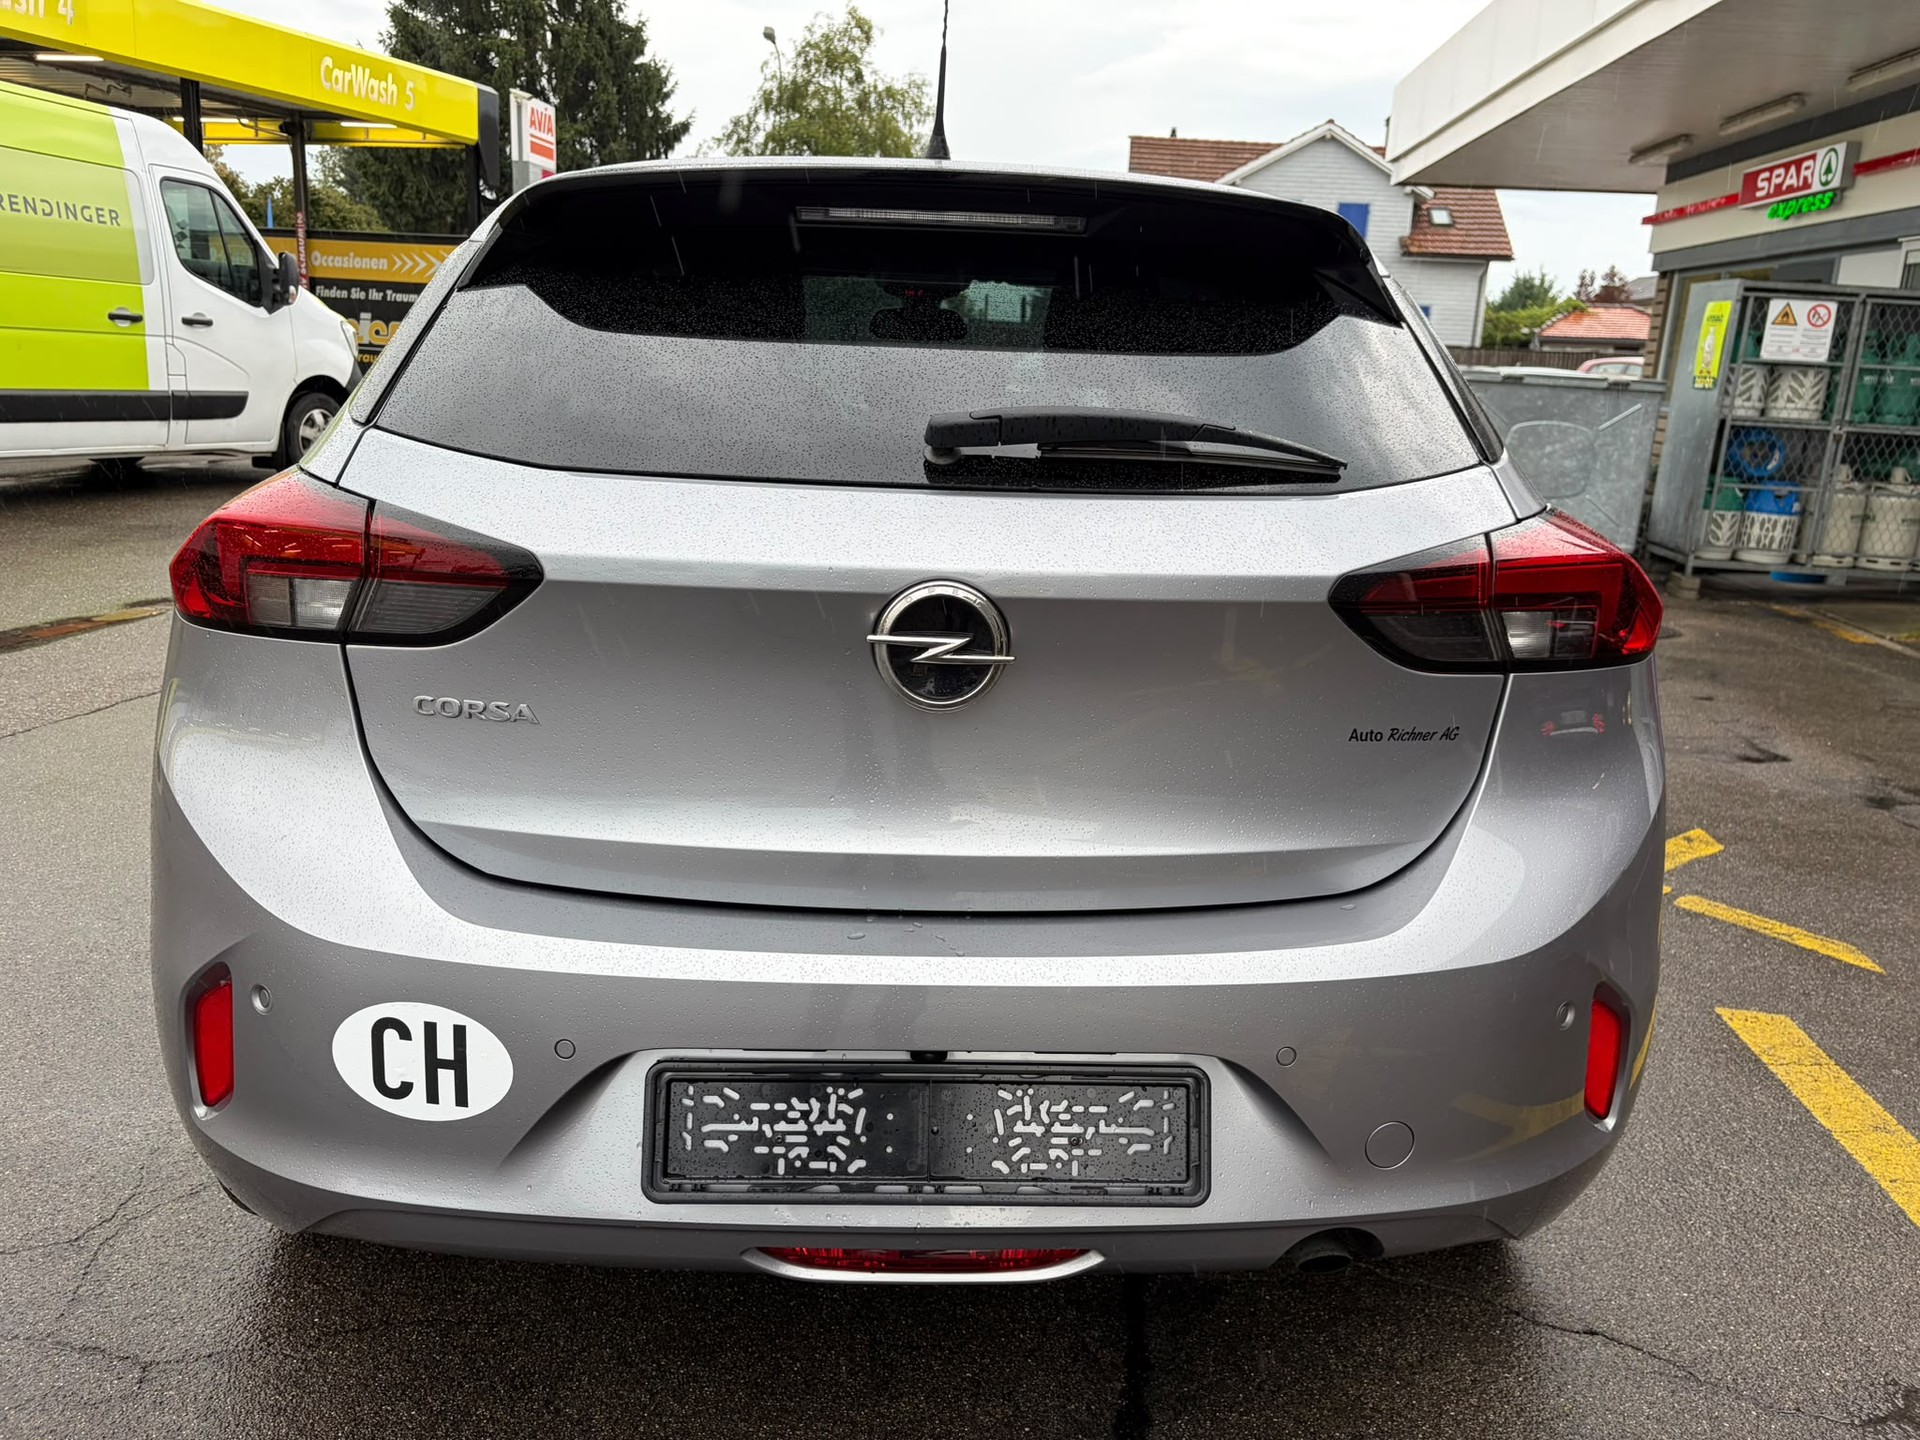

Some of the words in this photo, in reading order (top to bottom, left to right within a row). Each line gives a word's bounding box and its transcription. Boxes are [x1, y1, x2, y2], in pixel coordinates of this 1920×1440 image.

[58, 0, 75, 26] 4
[321, 56, 398, 106] CarWash
[405, 80, 416, 111] 5
[529, 106, 554, 137] AVIA
[1755, 158, 1815, 198] SPAR
[1766, 191, 1837, 221] express
[311, 251, 388, 271] Occasionen
[315, 285, 348, 299] Finden
[350, 287, 366, 300] Sie
[368, 288, 383, 301] Ihr
[412, 695, 541, 725] CORSA
[1348, 728, 1384, 742] Auto
[1387, 726, 1438, 742] Richner
[1439, 726, 1460, 741] AG
[371, 1016, 469, 1108] CH
